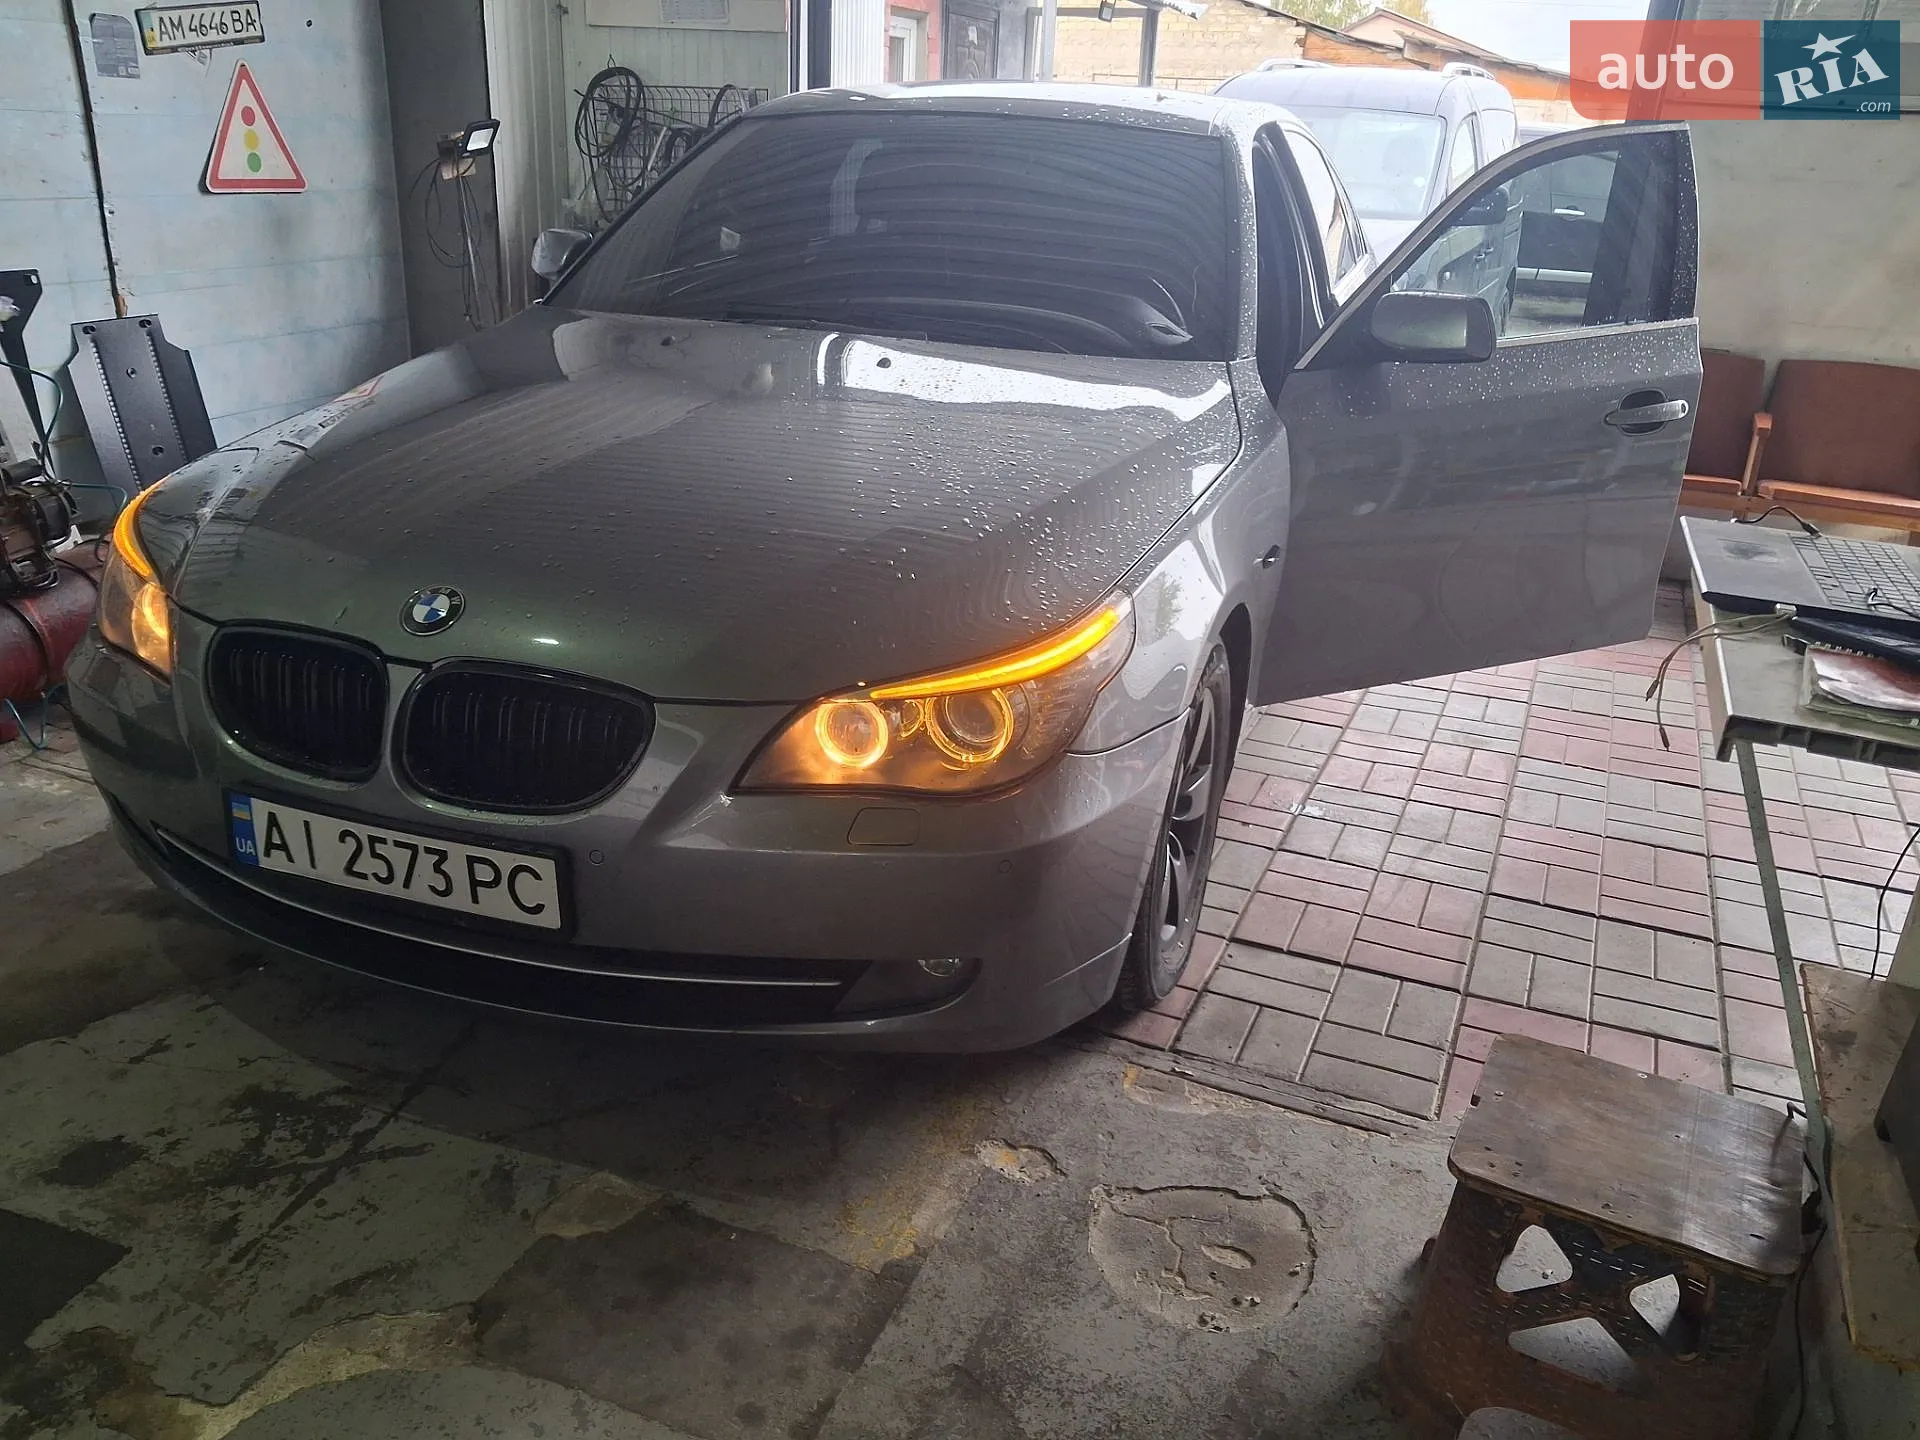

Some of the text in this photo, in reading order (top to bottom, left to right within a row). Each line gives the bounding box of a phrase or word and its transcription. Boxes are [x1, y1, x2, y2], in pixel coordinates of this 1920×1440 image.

[159, 9, 257, 41] AM 4646 BA
[236, 836, 256, 856] UA
[263, 811, 546, 915] AI 2573 PC
